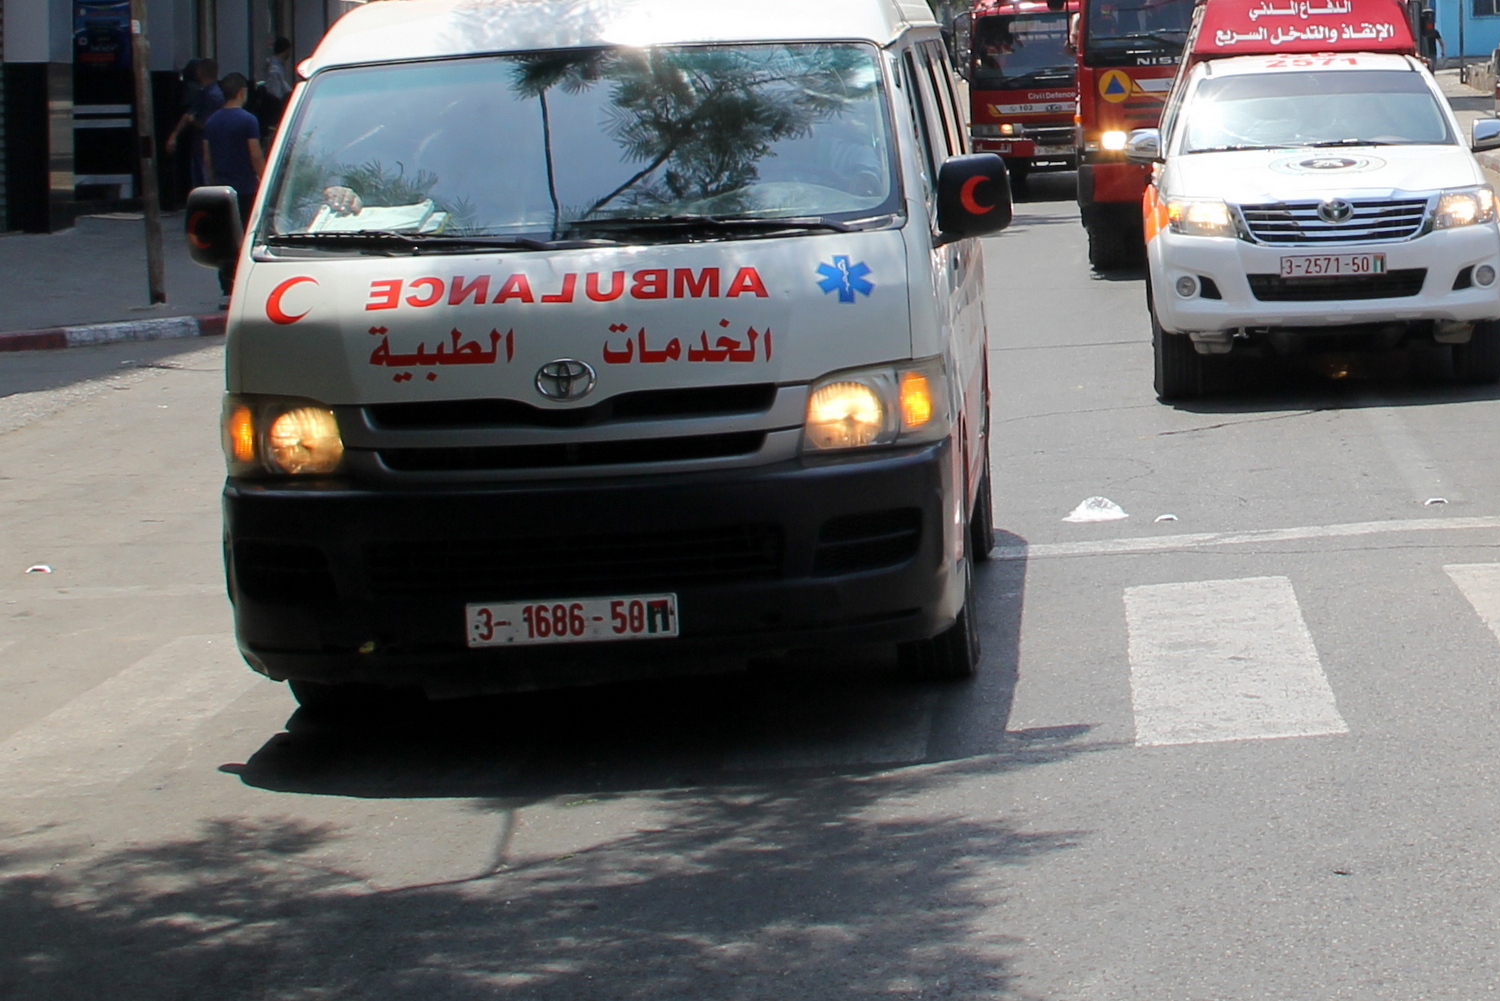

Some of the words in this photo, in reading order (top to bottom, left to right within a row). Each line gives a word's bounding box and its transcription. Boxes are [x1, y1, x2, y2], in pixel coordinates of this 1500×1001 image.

[1249, 0, 1298, 21] المدني
[1300, 0, 1352, 19] الدفاع
[1215, 27, 1268, 47] السريع
[1270, 25, 1338, 45] والتدخل
[1341, 22, 1394, 42] الإنقاذ
[1265, 57, 1358, 68] 2571
[603, 317, 772, 366] الخدمات
[368, 324, 515, 383] الطبية
